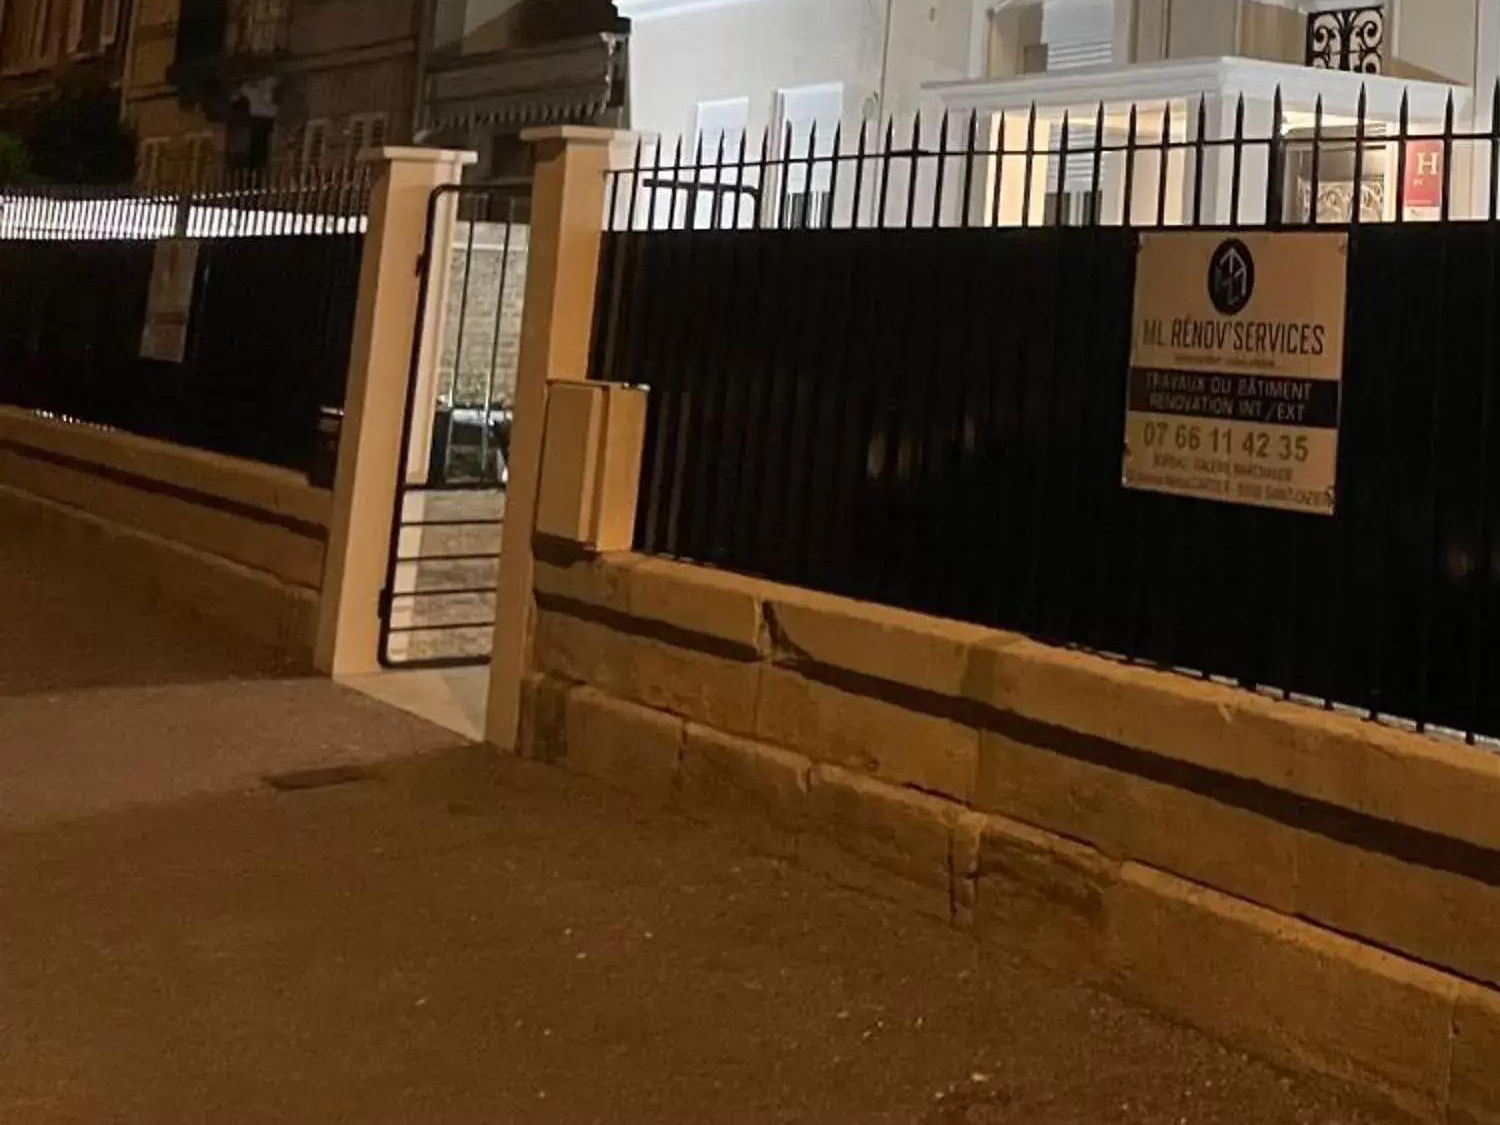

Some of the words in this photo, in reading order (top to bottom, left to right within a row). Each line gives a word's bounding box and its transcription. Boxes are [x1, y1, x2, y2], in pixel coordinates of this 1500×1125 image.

[1416, 151, 1438, 175] H
[1146, 372, 1205, 393] TRAVAUX
[1210, 376, 1231, 394] DU
[1143, 422, 1169, 447] 07
[1175, 425, 1200, 451] 66
[1209, 429, 1232, 455] 11
[1242, 432, 1271, 459] 42
[1279, 435, 1310, 464] 35
